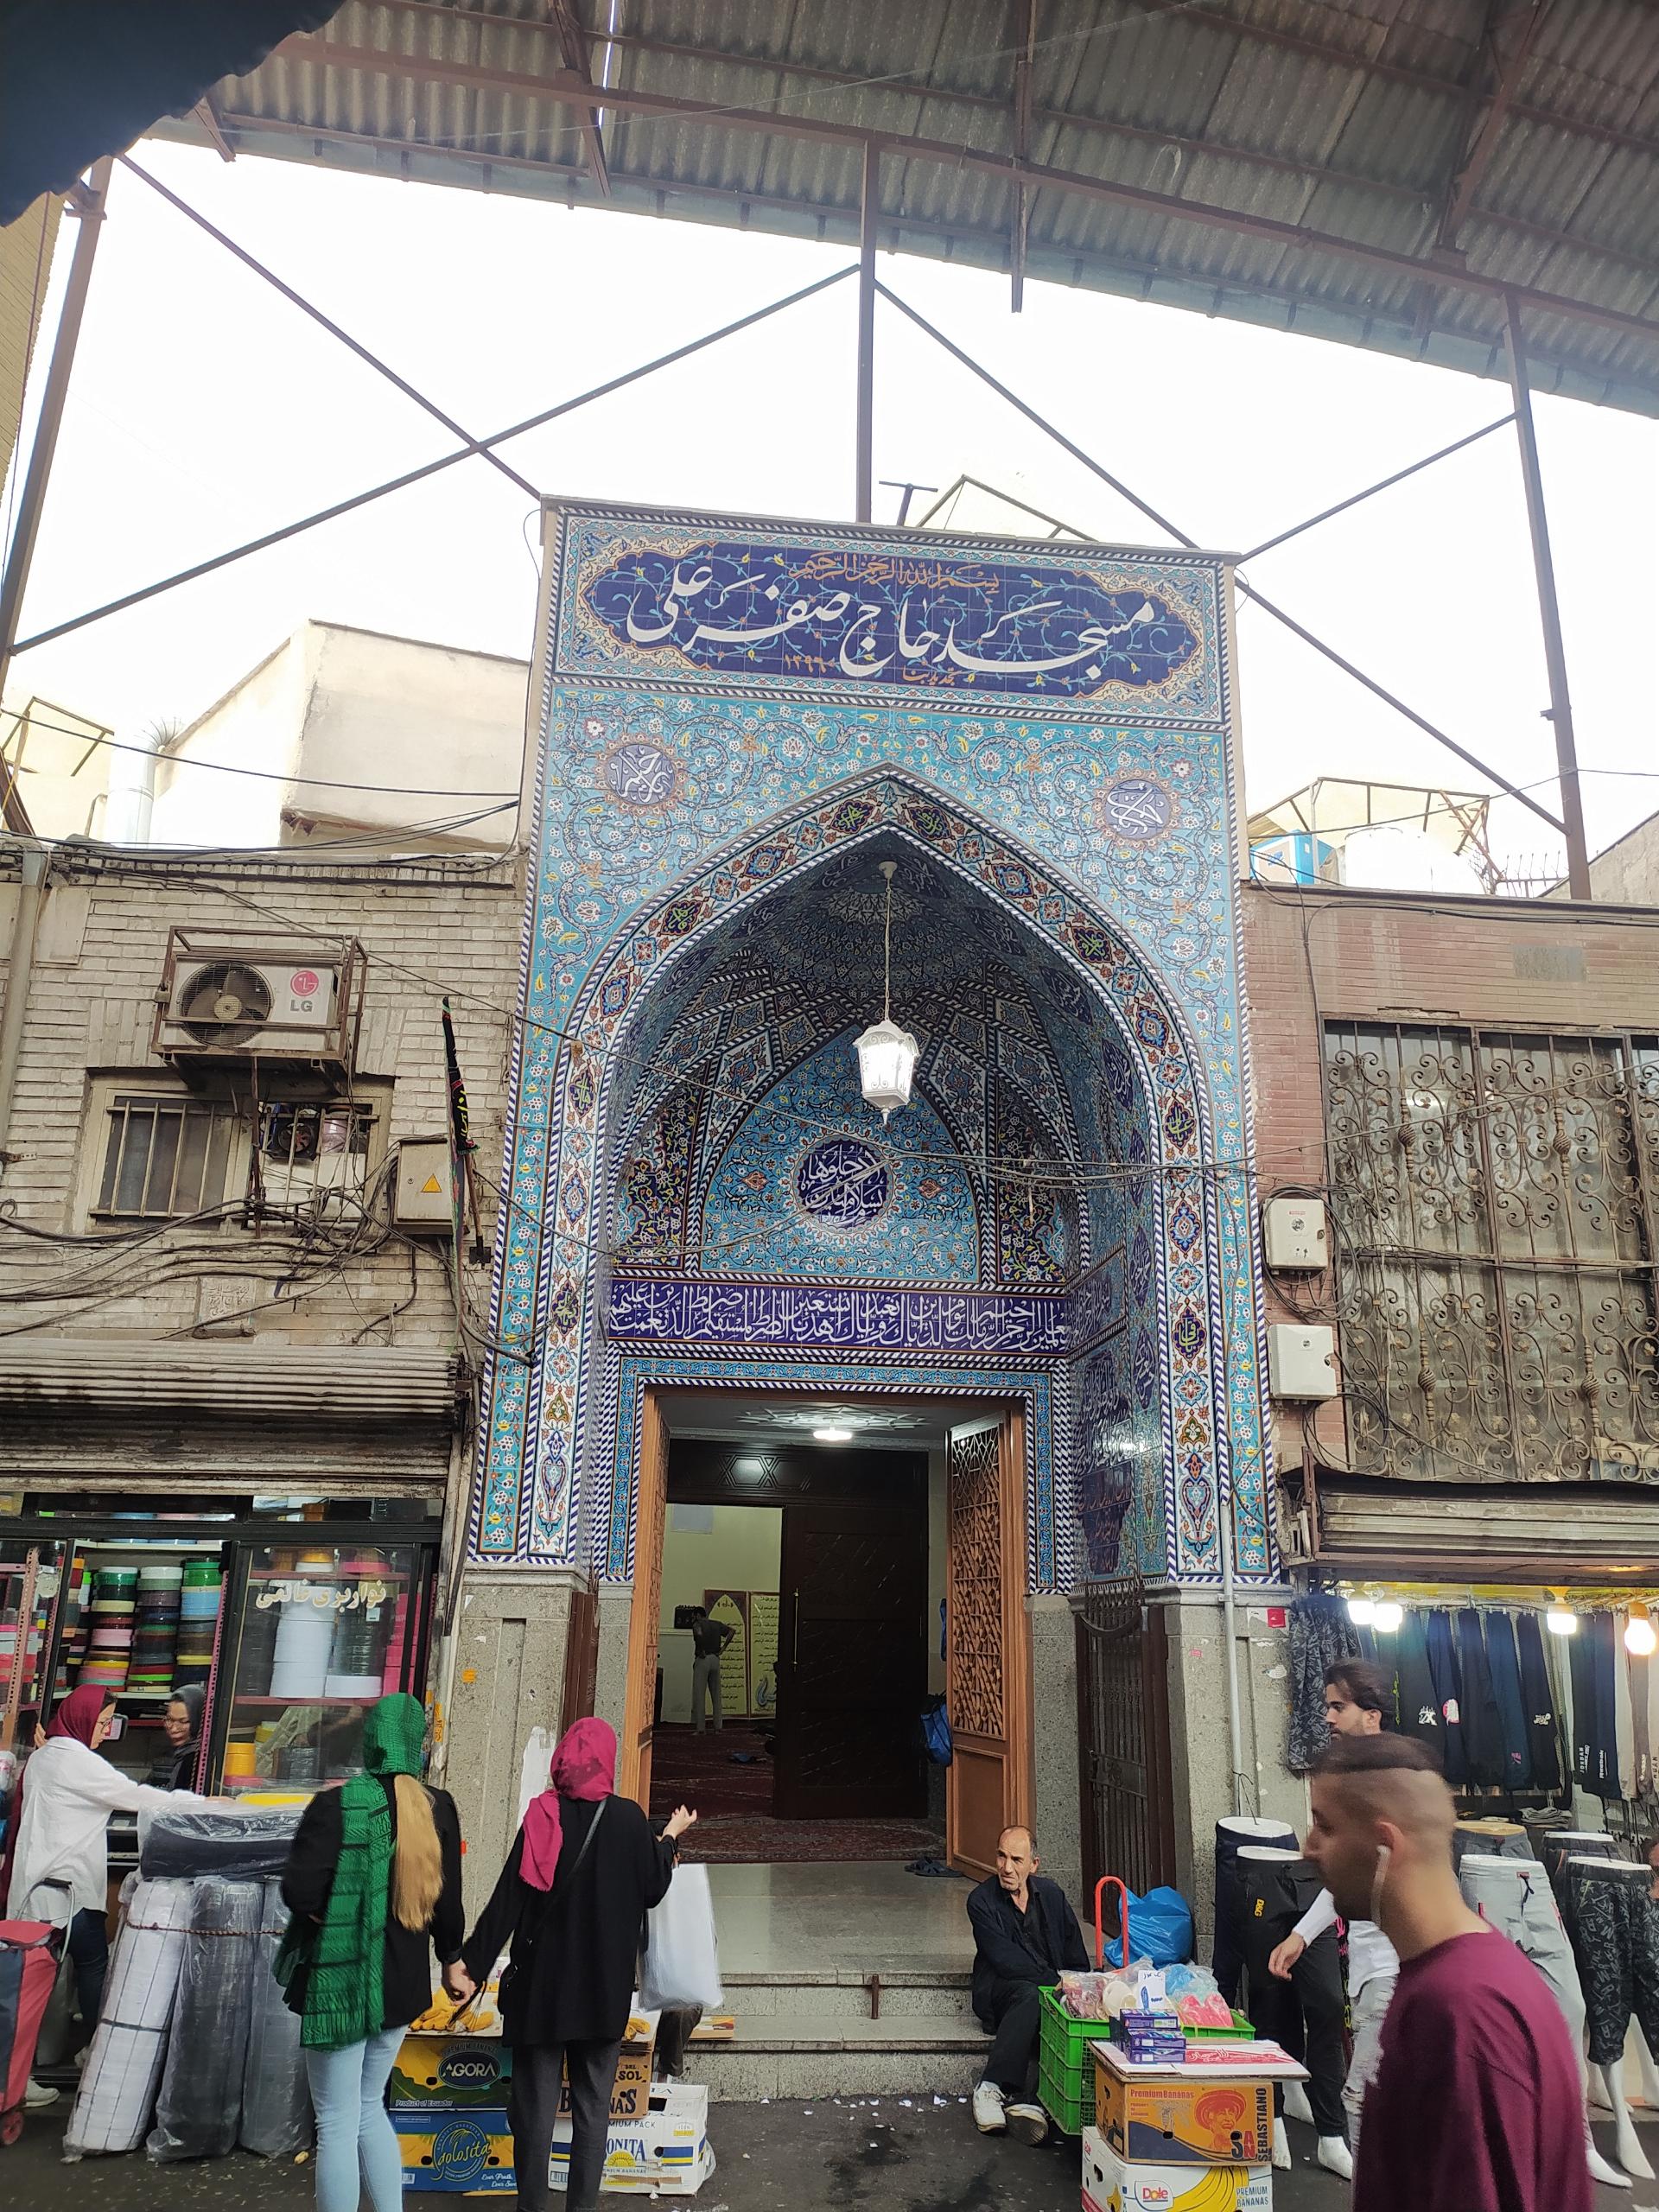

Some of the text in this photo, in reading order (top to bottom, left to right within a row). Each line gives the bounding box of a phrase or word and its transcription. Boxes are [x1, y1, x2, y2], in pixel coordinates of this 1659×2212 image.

[839, 600, 939, 677] حاج
[932, 599, 1154, 678] مسجد
[290, 1000, 313, 1012] LG
[1255, 1898, 1264, 1916] D&G
[442, 2063, 497, 2077] AGORA
[619, 2070, 642, 2081] SOL
[1130, 2088, 1194, 2099] Premium Bananas
[608, 2120, 632, 2128] MIUM
[1255, 2088, 1268, 2162] SEBASTIANO
[606, 2138, 646, 2162] ONITA
[1142, 2187, 1168, 2200] Dole
[1236, 2186, 1268, 2196] PREMIUM
[1236, 2196, 1268, 2208] BANANAS
